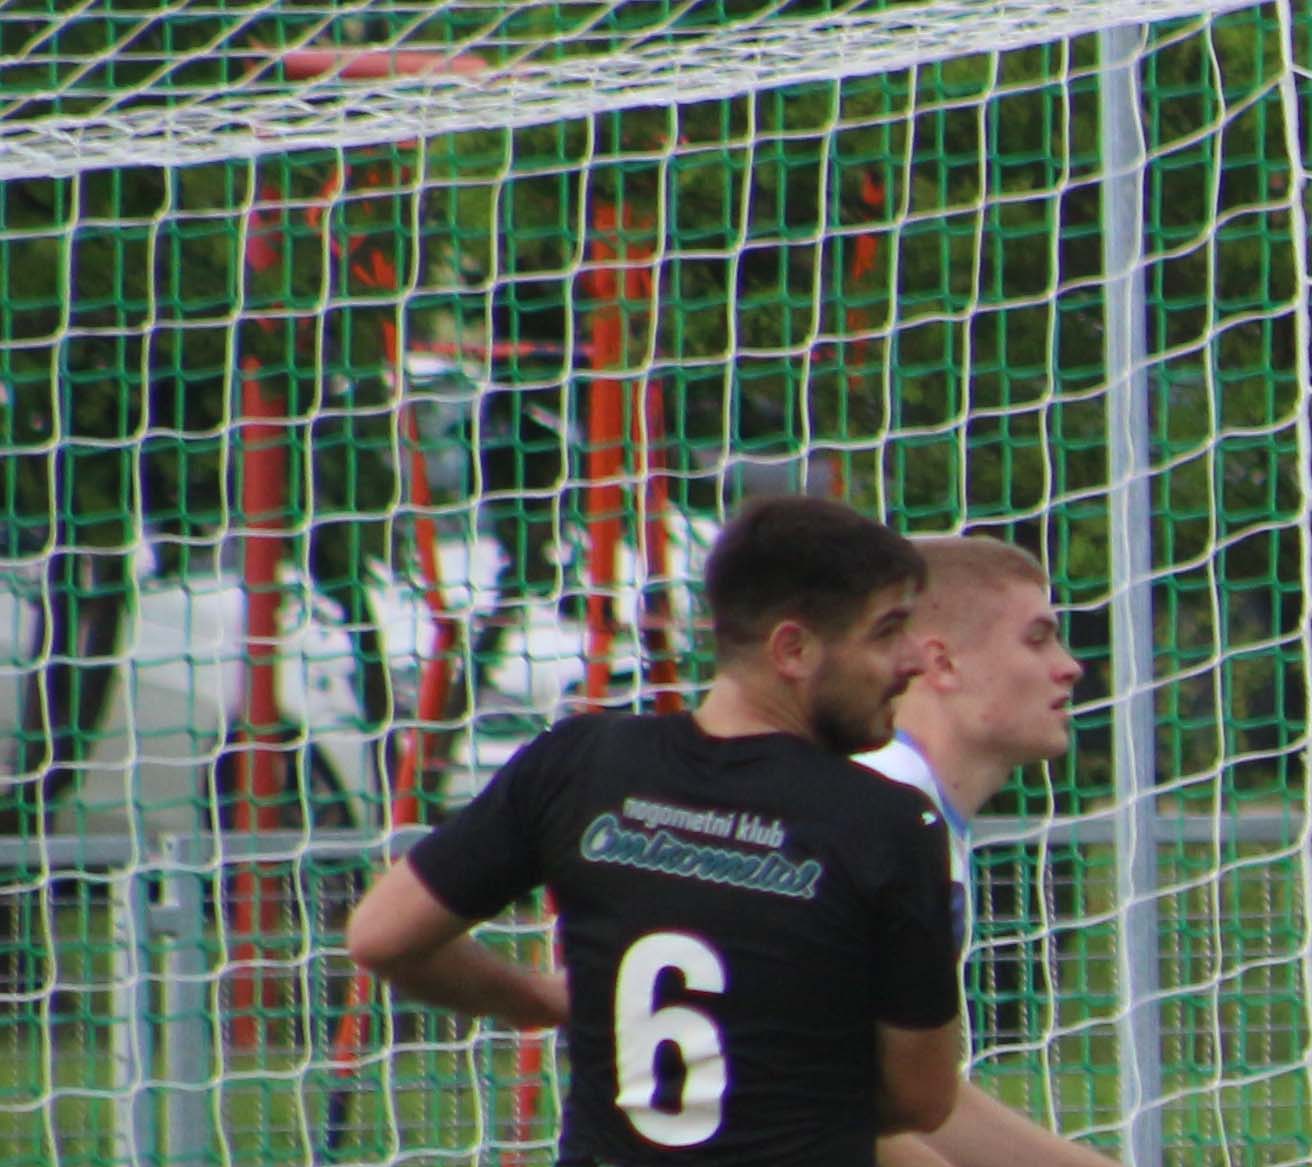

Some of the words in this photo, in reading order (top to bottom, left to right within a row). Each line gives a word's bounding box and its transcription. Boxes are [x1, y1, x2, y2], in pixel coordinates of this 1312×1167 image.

[622, 797, 735, 838] nogometni
[735, 812, 785, 849] klub
[614, 931, 728, 1147] 6
